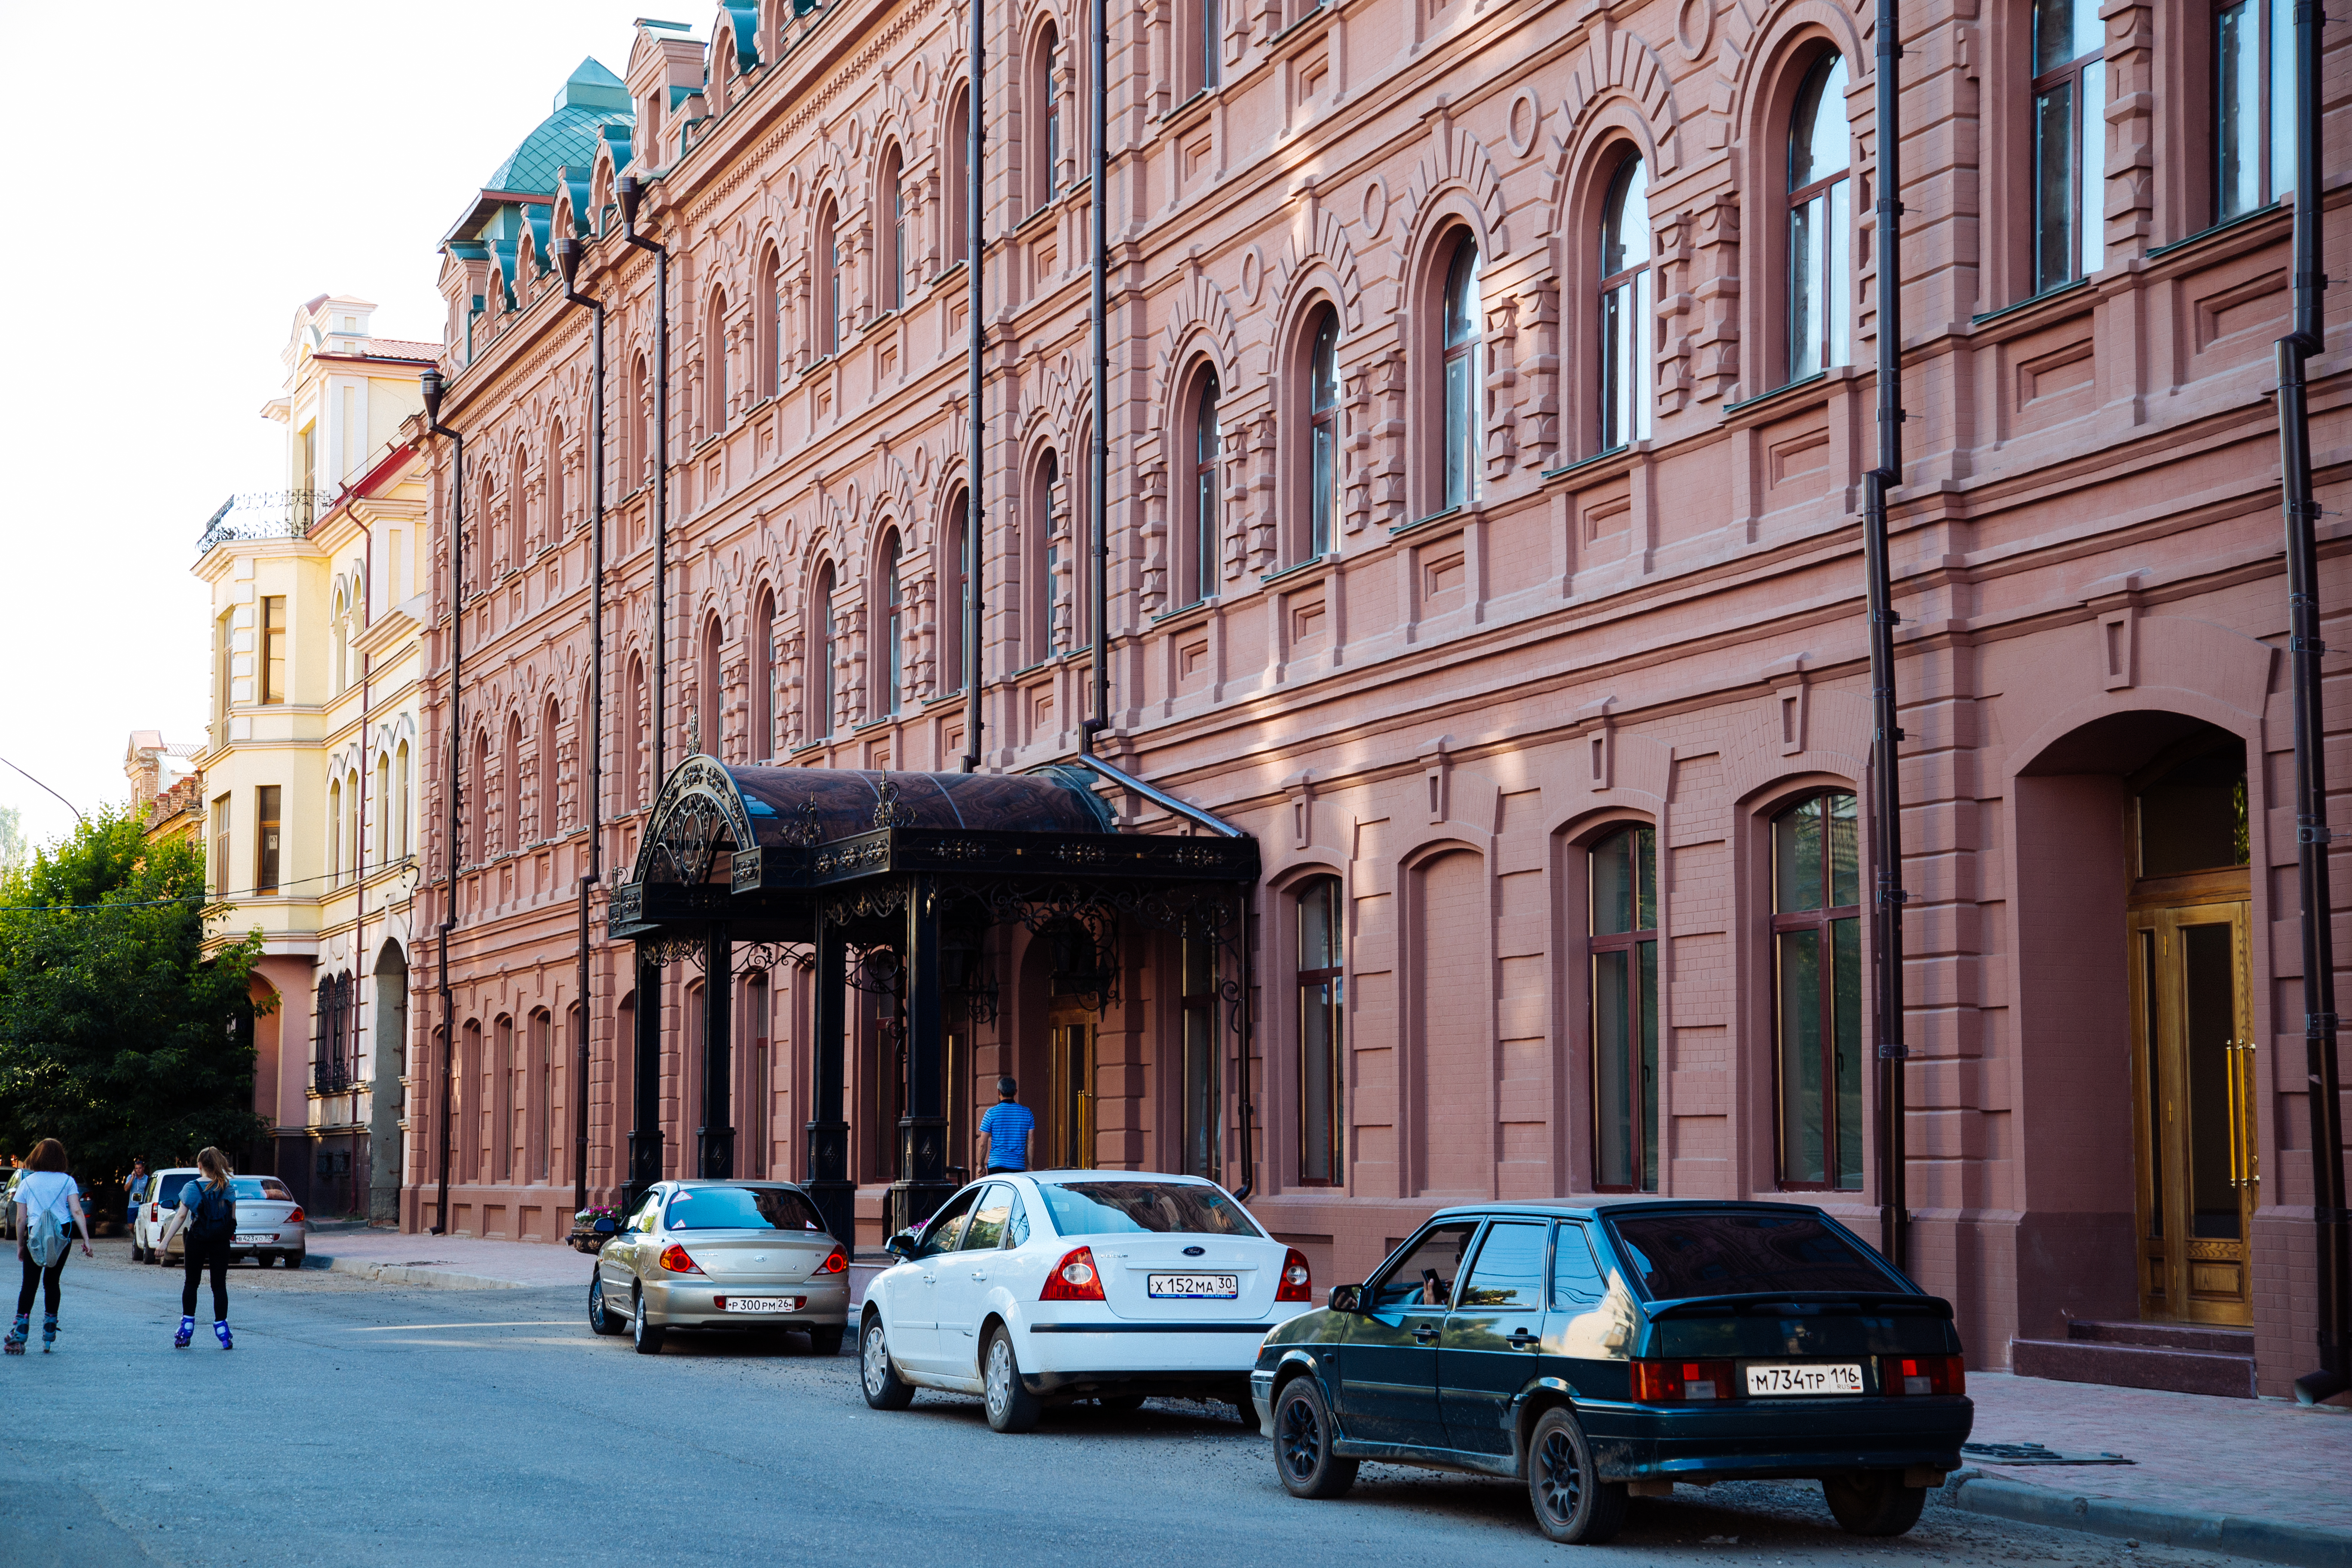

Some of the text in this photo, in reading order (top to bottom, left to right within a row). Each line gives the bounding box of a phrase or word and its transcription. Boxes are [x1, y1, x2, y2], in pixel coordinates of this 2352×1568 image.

[1218, 1277, 1232, 1289] 30
[778, 1299, 789, 1308] 26
[1831, 1368, 1856, 1383] 116
